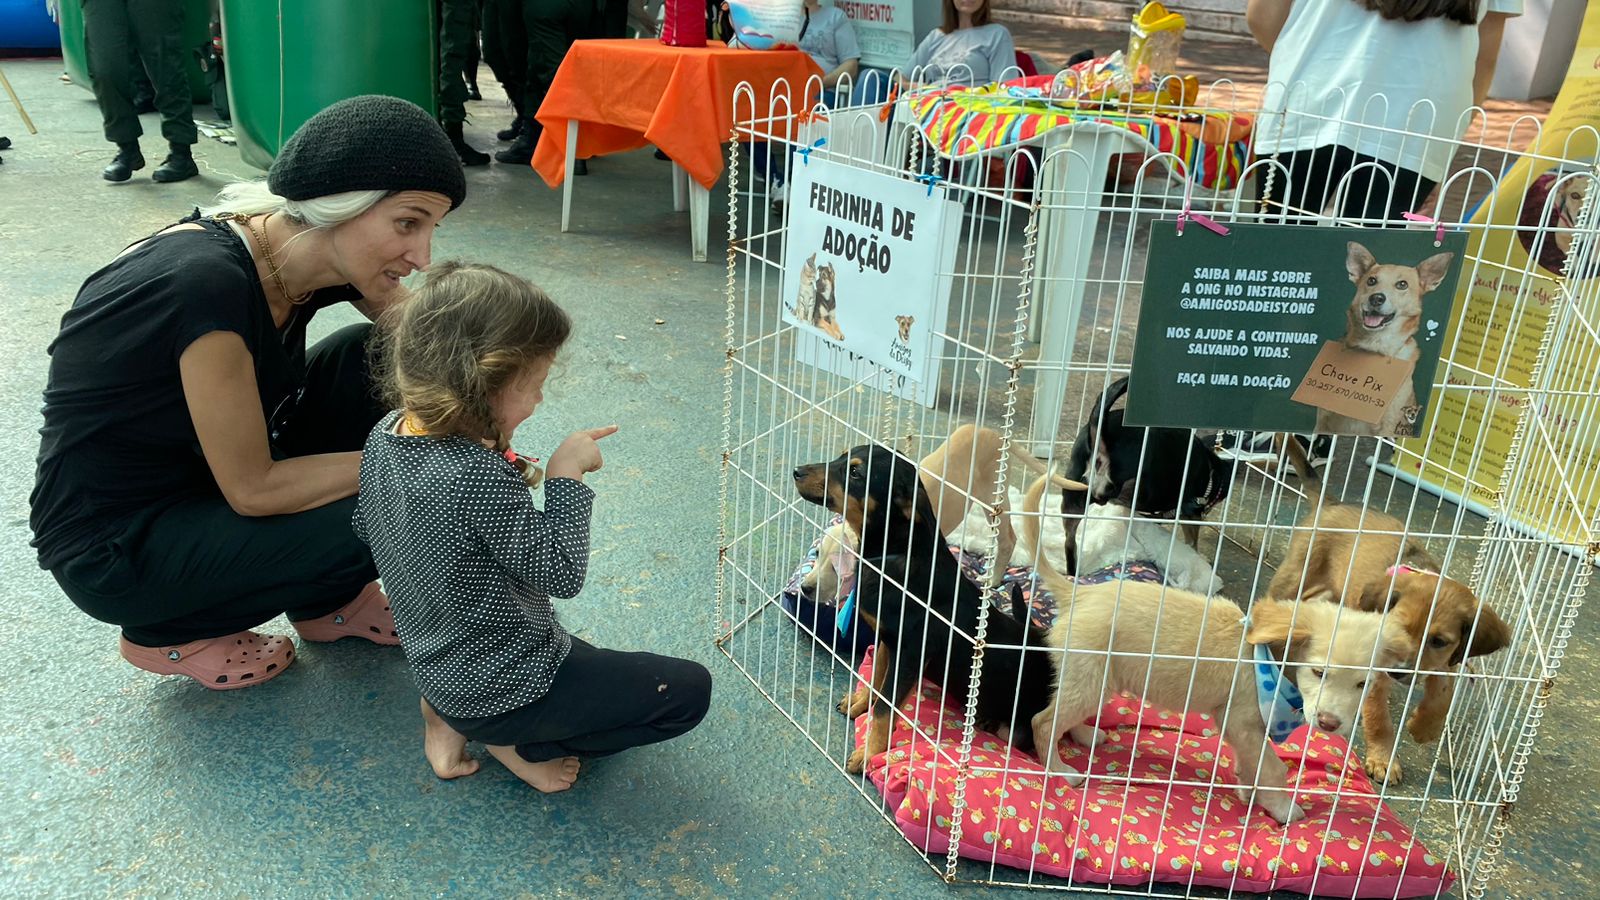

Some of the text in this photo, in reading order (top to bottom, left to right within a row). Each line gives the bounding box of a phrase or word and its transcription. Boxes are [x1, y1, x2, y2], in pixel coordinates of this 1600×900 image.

[809, 181, 916, 241] FEIRINHA DE
[822, 225, 891, 274] ADOÇÃO
[1193, 267, 1312, 284] SAIBA MAIS SOBRE
[1181, 282, 1318, 300] A ONG NO INSTAGRAM
[1180, 297, 1316, 314] @AMIGOSDADEISY.ONG
[1166, 327, 1318, 345] NOS AJUDE A CONTINUAR
[1187, 343, 1291, 359] SALVANDO VIDAS.
[1177, 372, 1291, 390] FAÇA UMA DOAÇÃO
[1321, 363, 1384, 392] Chave Pix
